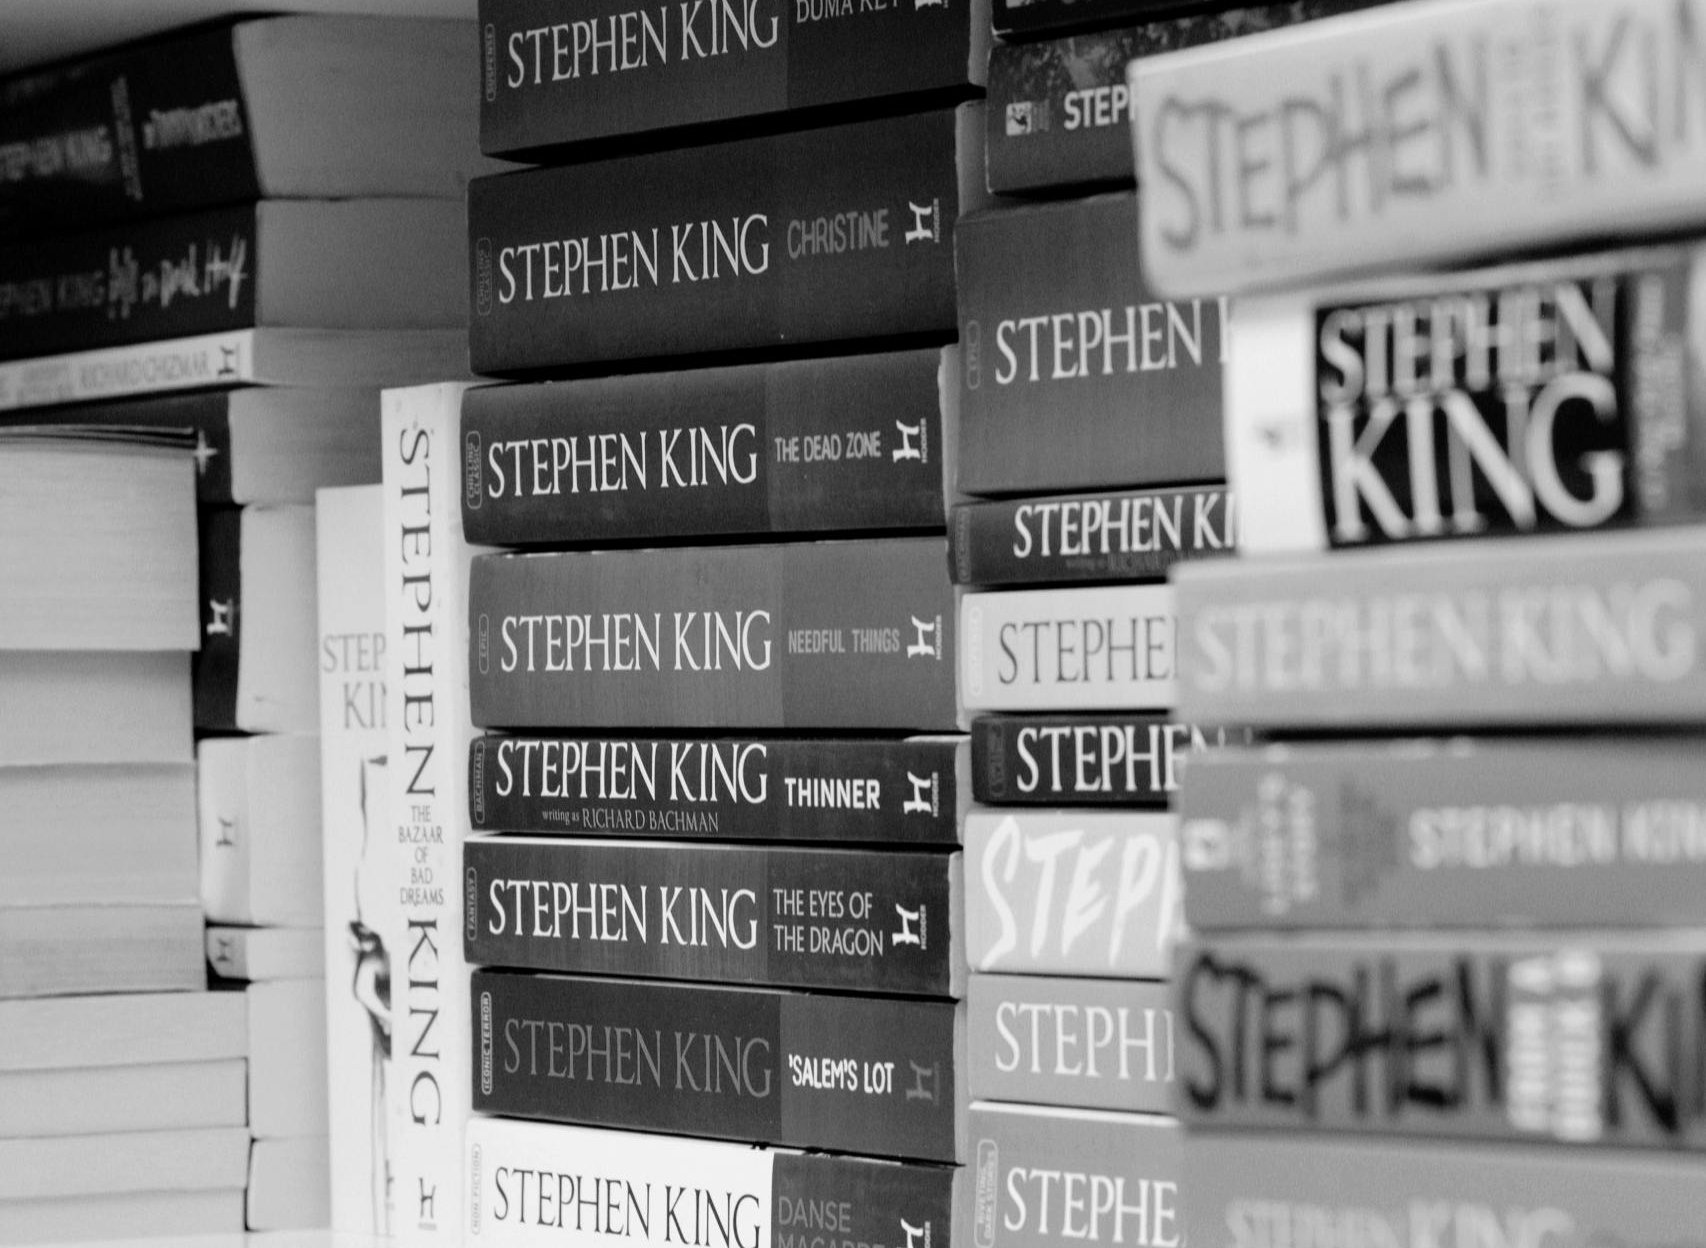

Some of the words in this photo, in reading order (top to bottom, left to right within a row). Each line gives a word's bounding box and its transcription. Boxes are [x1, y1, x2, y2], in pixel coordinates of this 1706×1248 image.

[508, 6, 667, 88] STEPHEN
[680, 0, 778, 61] KING
[1150, 30, 1490, 252] STEPHEN
[499, 228, 658, 304] STEPHEN
[671, 213, 769, 283] KING
[787, 209, 889, 259] CHRISTINE
[994, 296, 1201, 385] STEPHEN
[1320, 278, 1617, 404] STEPHEN
[488, 430, 648, 498] STEPHEN
[659, 423, 758, 489] KING
[774, 436, 799, 462] THE
[804, 434, 841, 461] DEAD
[846, 431, 881, 459] ZONE
[1325, 370, 1625, 545] KING
[1013, 496, 1182, 558] STEPHEN
[400, 428, 436, 798] STEPHEN
[501, 612, 661, 673] STEPHEN
[674, 609, 771, 671] KING
[788, 629, 845, 654] NEEDFUL
[852, 628, 900, 653] THINGS
[495, 739, 656, 801] STEPHEN
[669, 742, 768, 804] KING
[784, 777, 880, 810] THINNER
[398, 825, 444, 844] BAZAAR
[411, 805, 432, 822] THE
[542, 810, 570, 825] writing
[572, 813, 580, 822] as
[582, 808, 646, 830] RICHARD
[649, 810, 719, 832] BACHMAN
[411, 867, 433, 884] BAD
[415, 846, 429, 863] OF
[400, 887, 444, 906] DREAMS
[488, 878, 648, 944] STEPHEN
[660, 885, 758, 950] KING
[773, 888, 805, 918] THE
[809, 890, 844, 919] EYES
[848, 892, 873, 919] OF
[773, 924, 805, 952] THE
[809, 926, 884, 957] DRAGON
[408, 918, 442, 1126] KING
[1183, 953, 1503, 1120] STEPHEN
[1600, 965, 1706, 1135] KI
[504, 1018, 662, 1089] STEPHEN
[674, 1031, 772, 1098] KING
[788, 1054, 858, 1091] 'SALEM'S
[863, 1061, 894, 1093] LOT
[493, 1166, 652, 1239] STEPHEN
[664, 1184, 761, 1248] KING
[778, 1195, 852, 1233] DANSE
